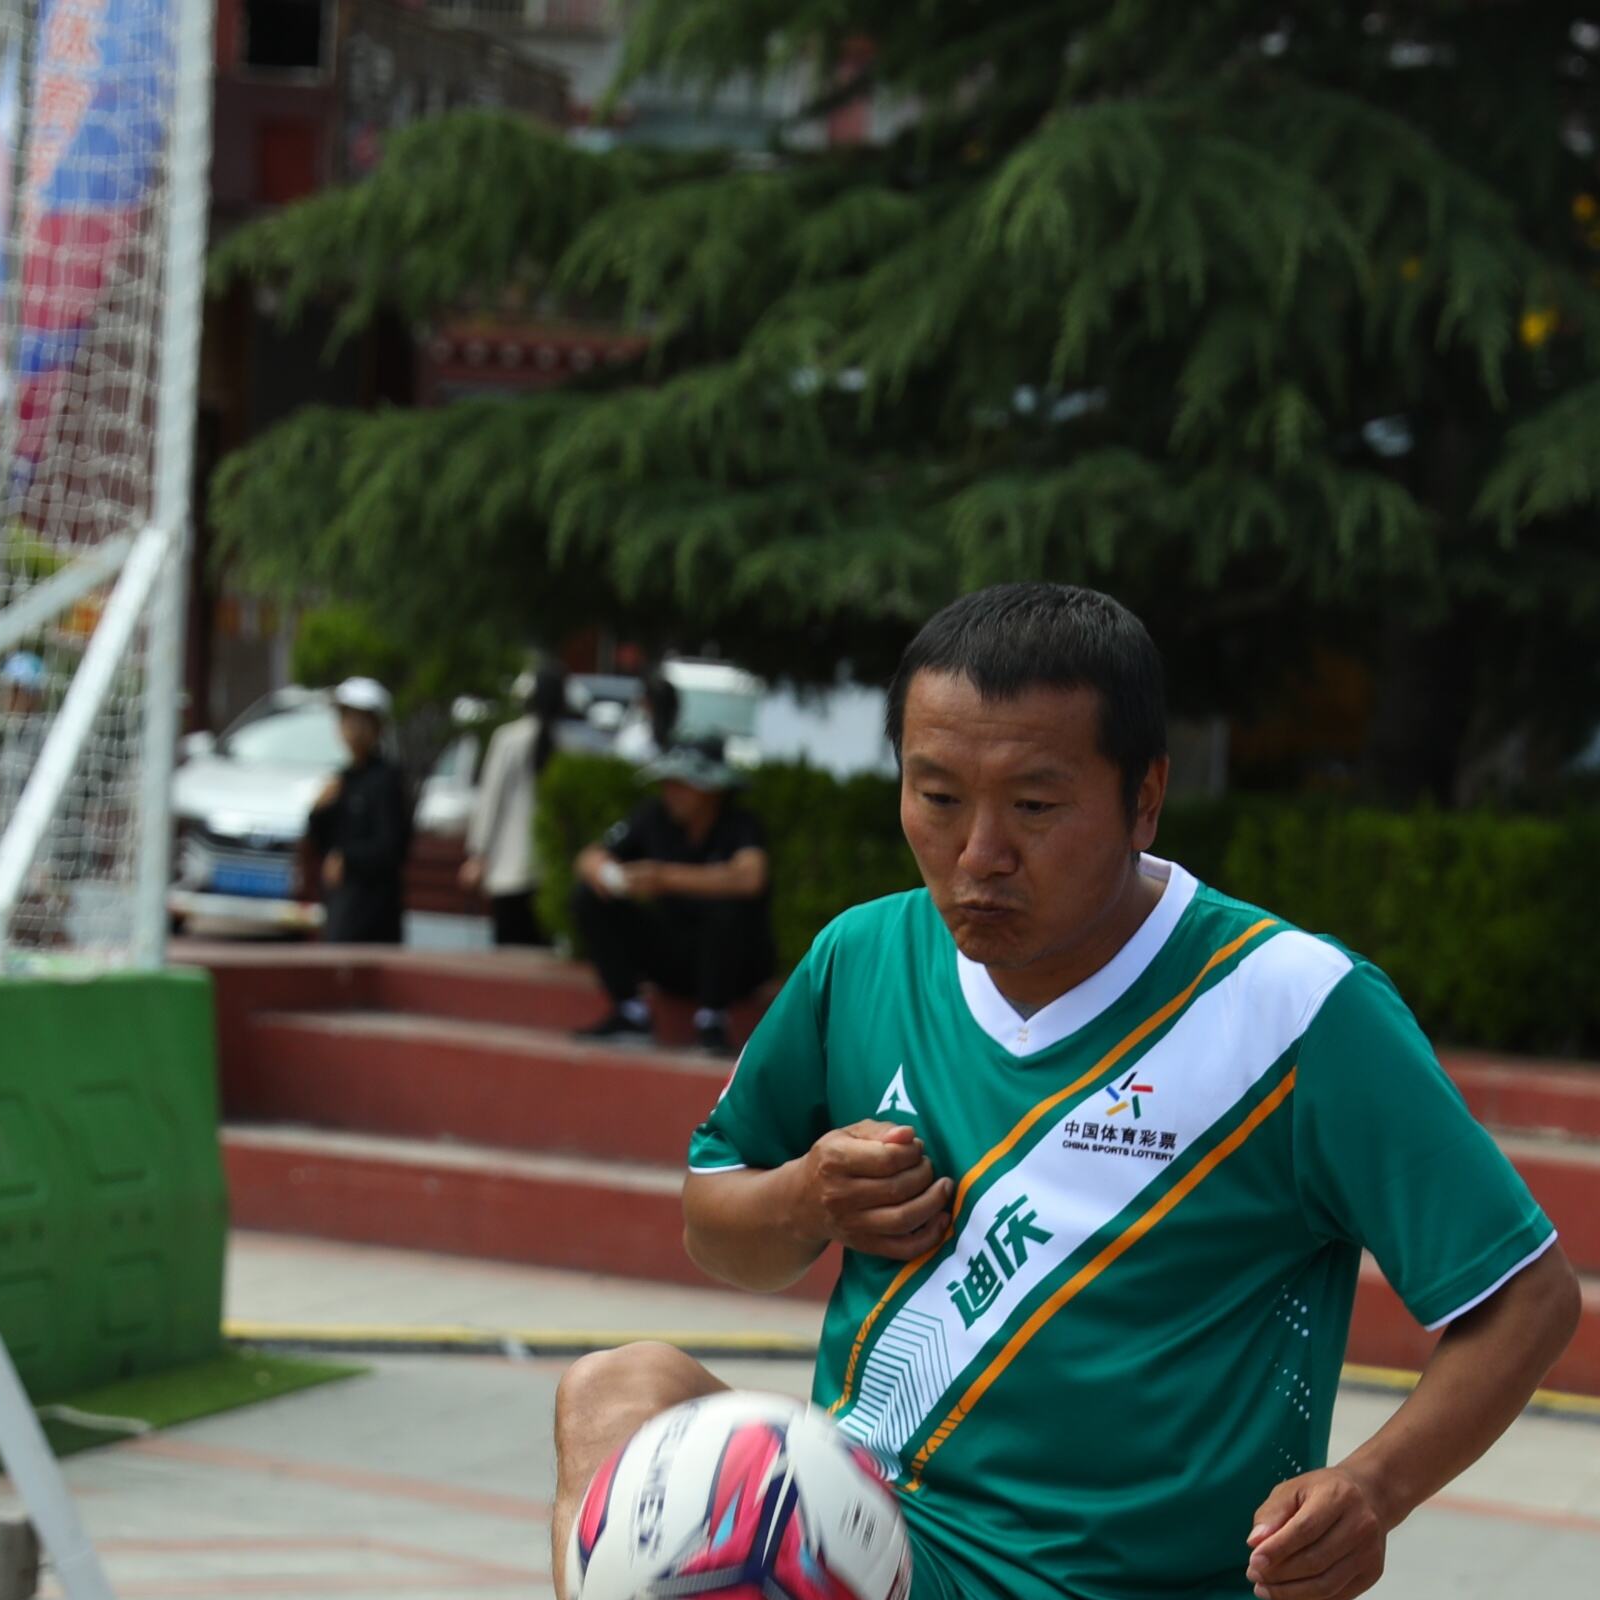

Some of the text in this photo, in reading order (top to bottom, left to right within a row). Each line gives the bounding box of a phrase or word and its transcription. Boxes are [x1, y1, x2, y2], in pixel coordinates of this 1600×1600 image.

[1064, 1120, 1177, 1149] 中国体育彩票
[1062, 1140, 1175, 1161] CHINA SPORTS LOTTERY
[946, 1193, 1055, 1331] 迪庆
